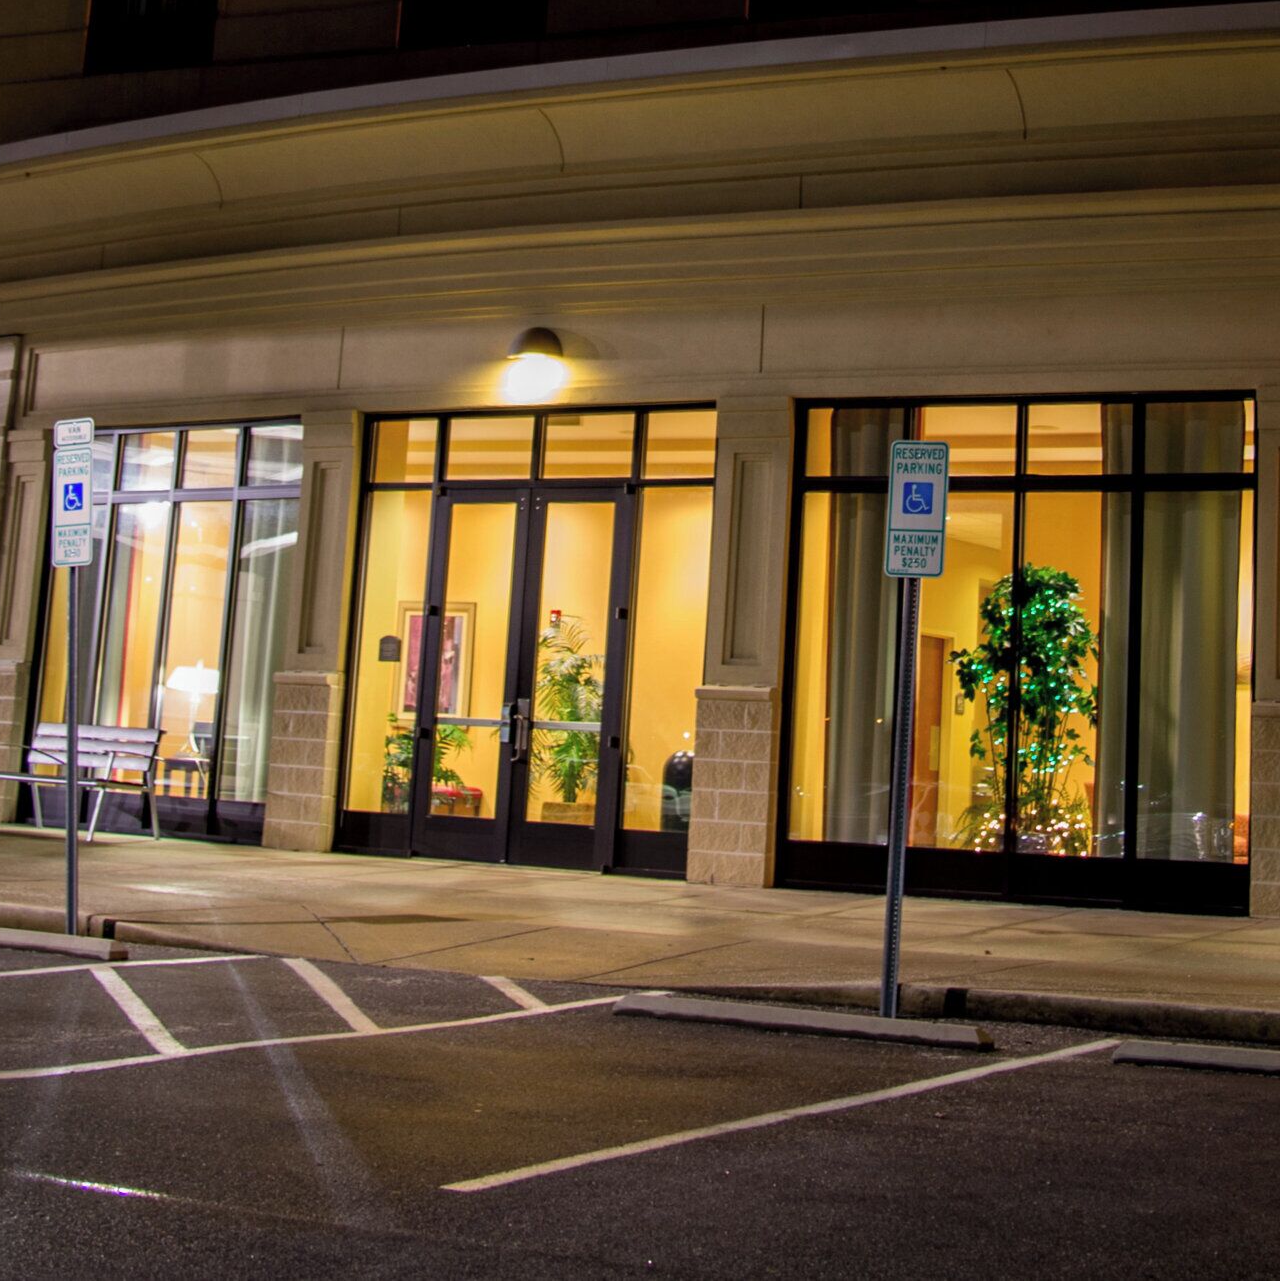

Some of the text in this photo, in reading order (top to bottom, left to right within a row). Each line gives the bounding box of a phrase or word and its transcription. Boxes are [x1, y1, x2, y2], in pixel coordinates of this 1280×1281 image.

[56, 452, 90, 465] RESERVED
[895, 447, 945, 460] RESERVED
[58, 465, 89, 477] PARKING
[896, 462, 943, 475] PARKING
[57, 528, 88, 538] MAXIMUM
[58, 538, 87, 548] PENALTY
[893, 534, 938, 545] MAXIMUM
[894, 546, 937, 557] PENALTY
[901, 557, 927, 568] $250
